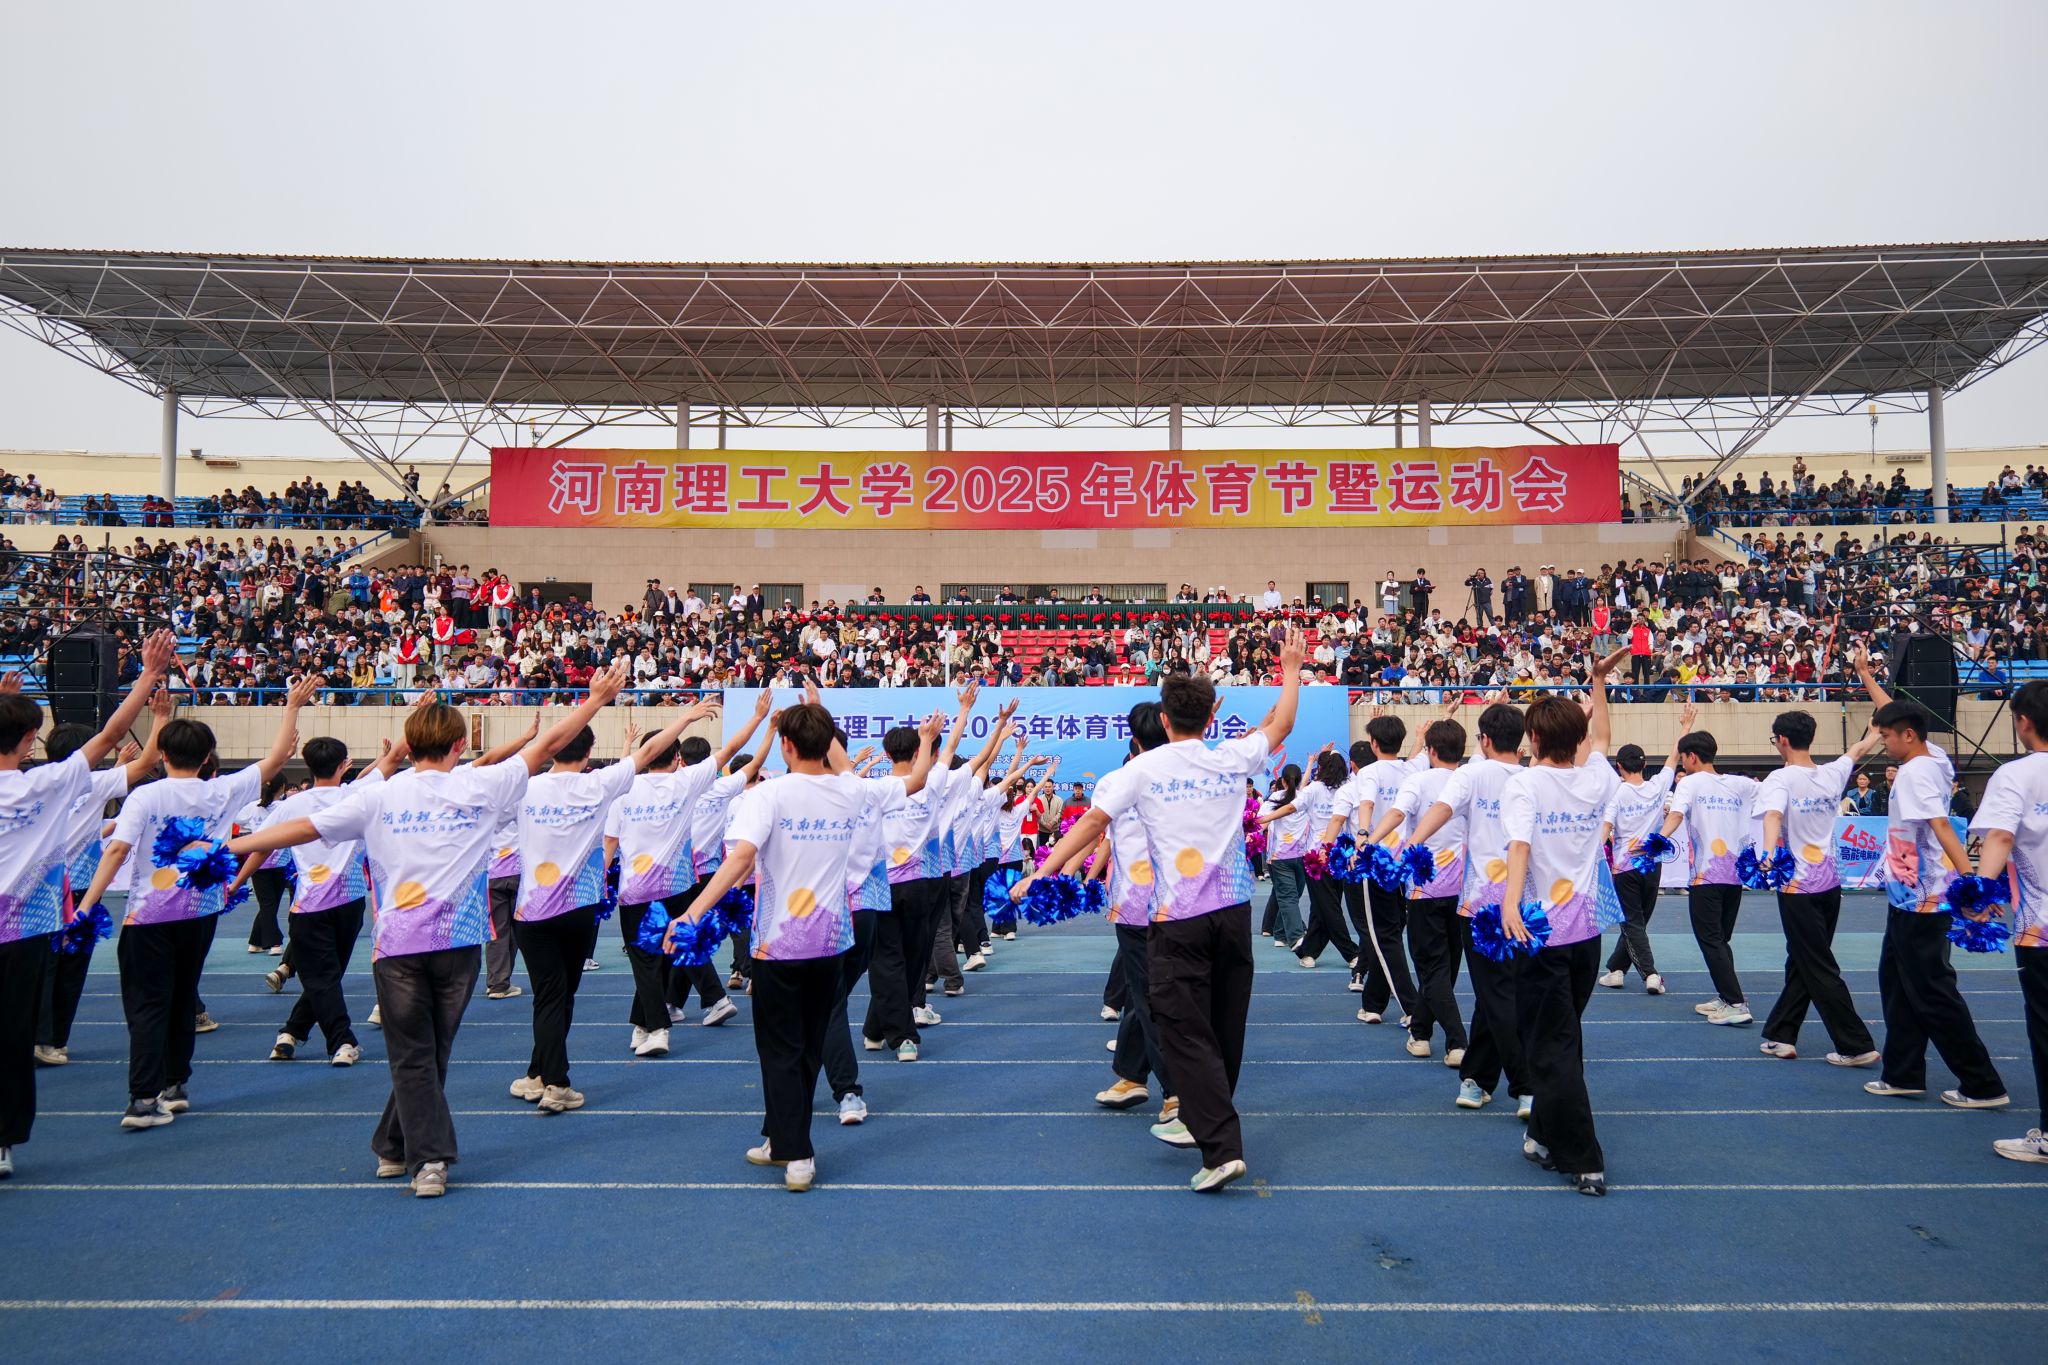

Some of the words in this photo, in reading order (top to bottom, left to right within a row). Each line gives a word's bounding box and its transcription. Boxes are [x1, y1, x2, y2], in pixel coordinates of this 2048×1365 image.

[549, 458, 1567, 517] 河南理工大学2025年体育节暨运动会
